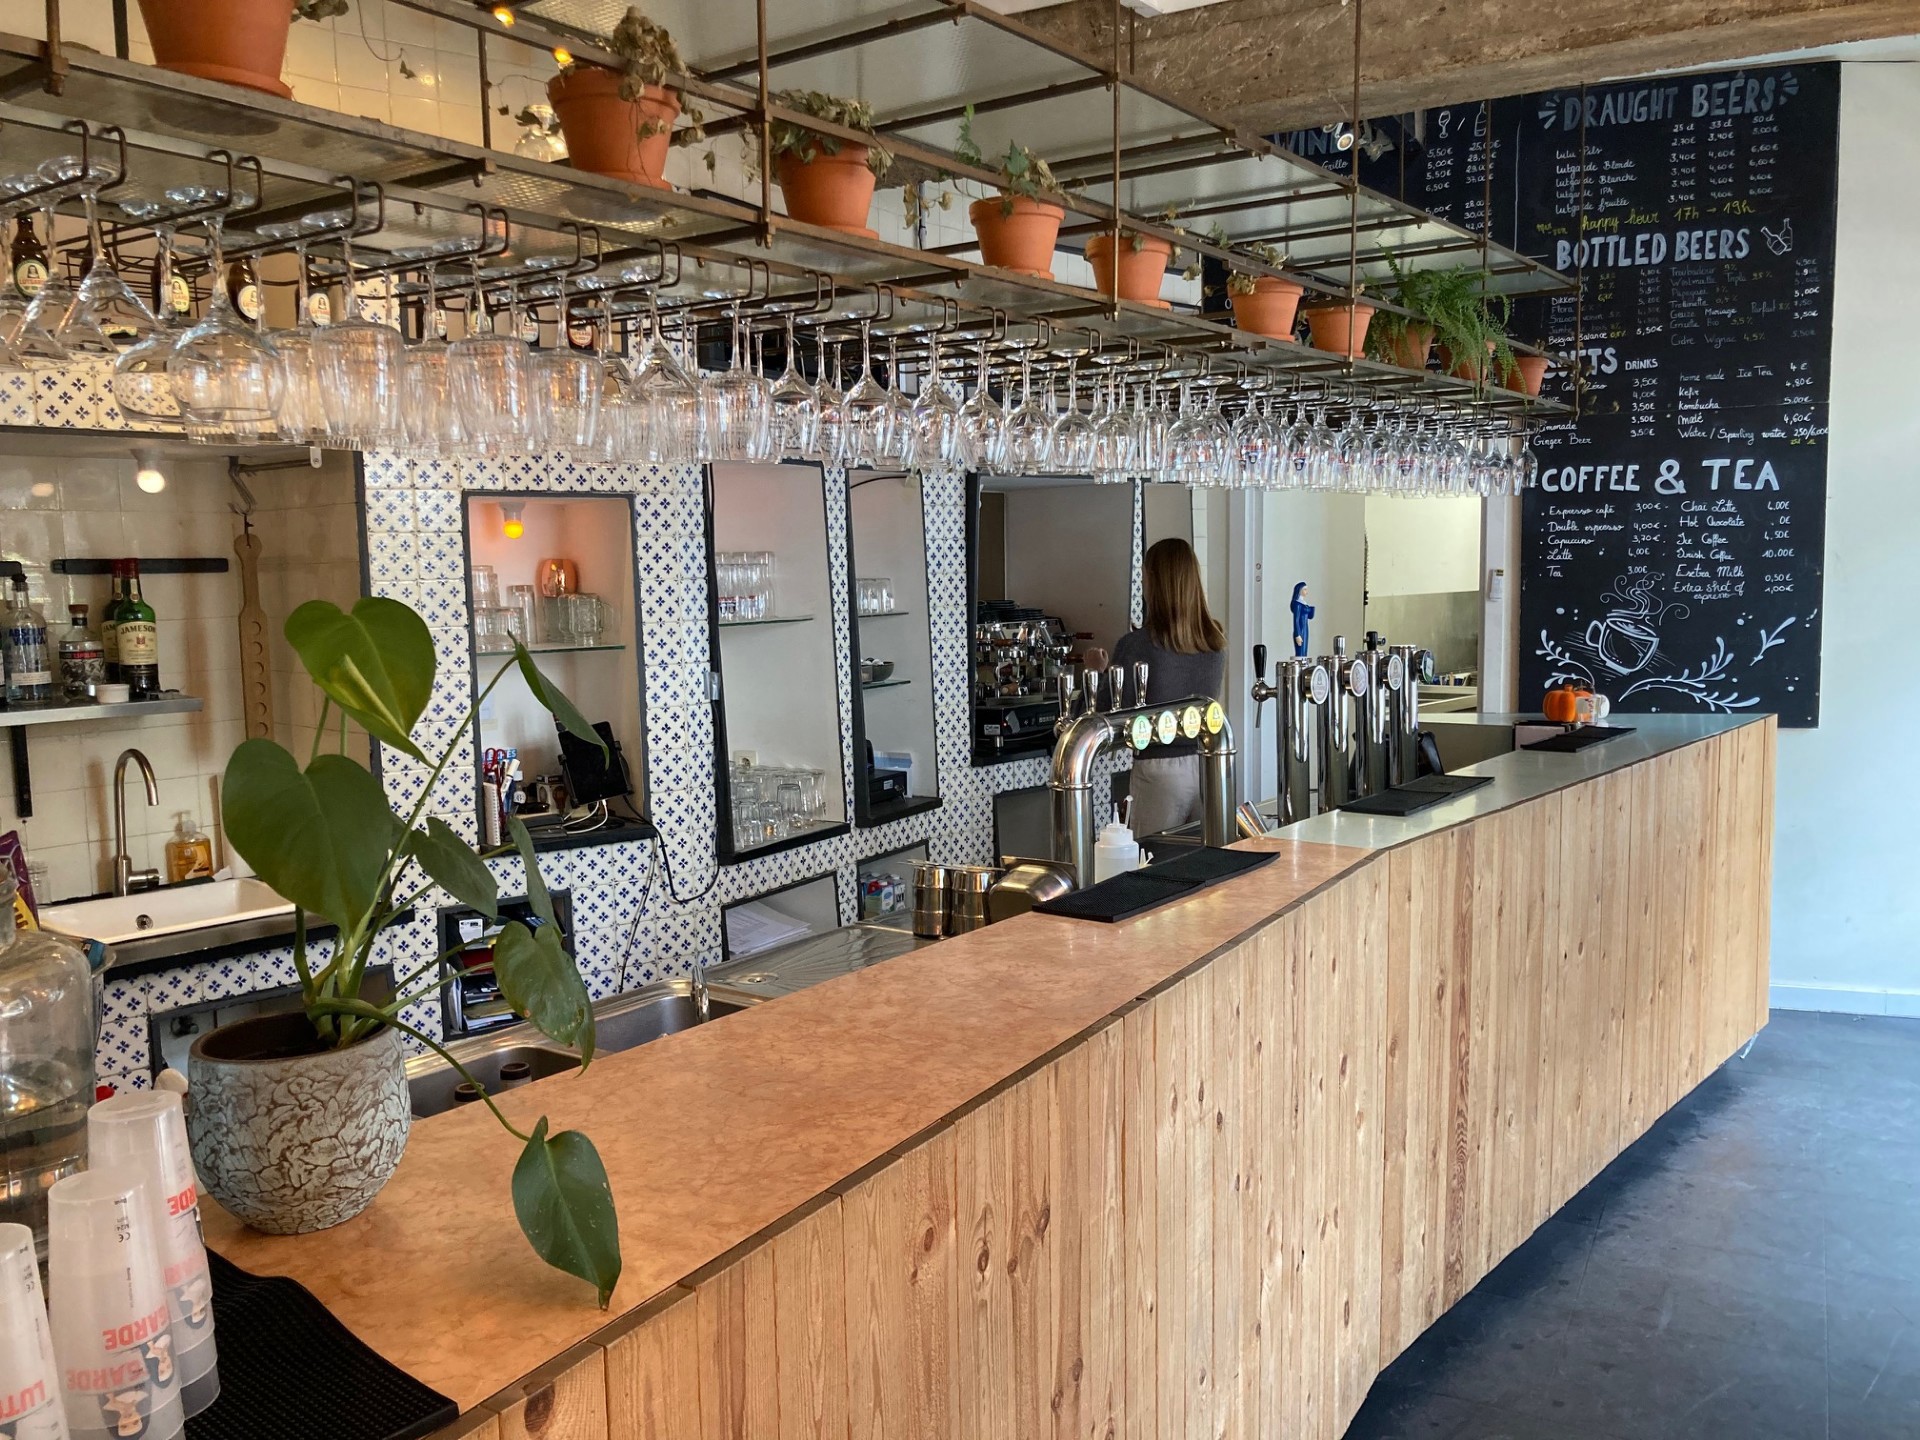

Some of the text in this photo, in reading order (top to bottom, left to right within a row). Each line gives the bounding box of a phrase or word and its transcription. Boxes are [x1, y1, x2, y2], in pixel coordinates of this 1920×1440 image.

[1564, 77, 1776, 131] DRAUGHT BEERS
[1673, 124, 1683, 132] 25
[1709, 121, 1721, 129] 33
[1603, 160, 1636, 170] Blonde
[1556, 173, 1638, 191] Lutgade Blanche
[1600, 187, 1614, 195] IPA
[1555, 202, 1594, 217] Lutgade
[1582, 215, 1619, 232] happy
[1624, 208, 1660, 224] hour
[1674, 207, 1699, 222] 17h
[1723, 200, 1756, 214] 19h
[1556, 228, 1750, 271] BOTTLED BEERS
[1552, 294, 1584, 305] Dikkenk
[1671, 333, 1696, 346] Cidre
[1625, 358, 1658, 370] DRINKS
[1736, 369, 1752, 378] Ice
[1754, 365, 1773, 376] Tea
[1632, 377, 1658, 388] 3,50€
[1632, 402, 1656, 412] 3,50€
[1678, 398, 1720, 410] Kombucha
[1678, 425, 1707, 439] Water
[1533, 433, 1592, 449] Ginger Beer
[1542, 459, 1780, 495] COFFEE & TEA
[1549, 504, 1615, 519] Espresso café
[1634, 503, 1661, 513] 3,00€
[1712, 499, 1738, 512] Latte
[1634, 523, 1660, 531] 4,00€
[1679, 514, 1745, 527] Hot Chocolate
[1547, 520, 1625, 536] Double espresso
[1548, 535, 1595, 549] Capuccino
[1632, 534, 1660, 543] 3,70€
[1701, 533, 1729, 547] Coffee
[1547, 548, 1574, 560] Latte
[1676, 547, 1735, 562] Irish Coffee
[1546, 565, 1563, 577] Tea
[1717, 566, 1744, 577] Milk
[1765, 574, 1793, 582] 0,50€
[1673, 581, 1745, 596] Extra shot of
[9, 627, 46, 637] ABSOLUT
[120, 625, 156, 635] JAMESON
[103, 1305, 172, 1351] GARDE
